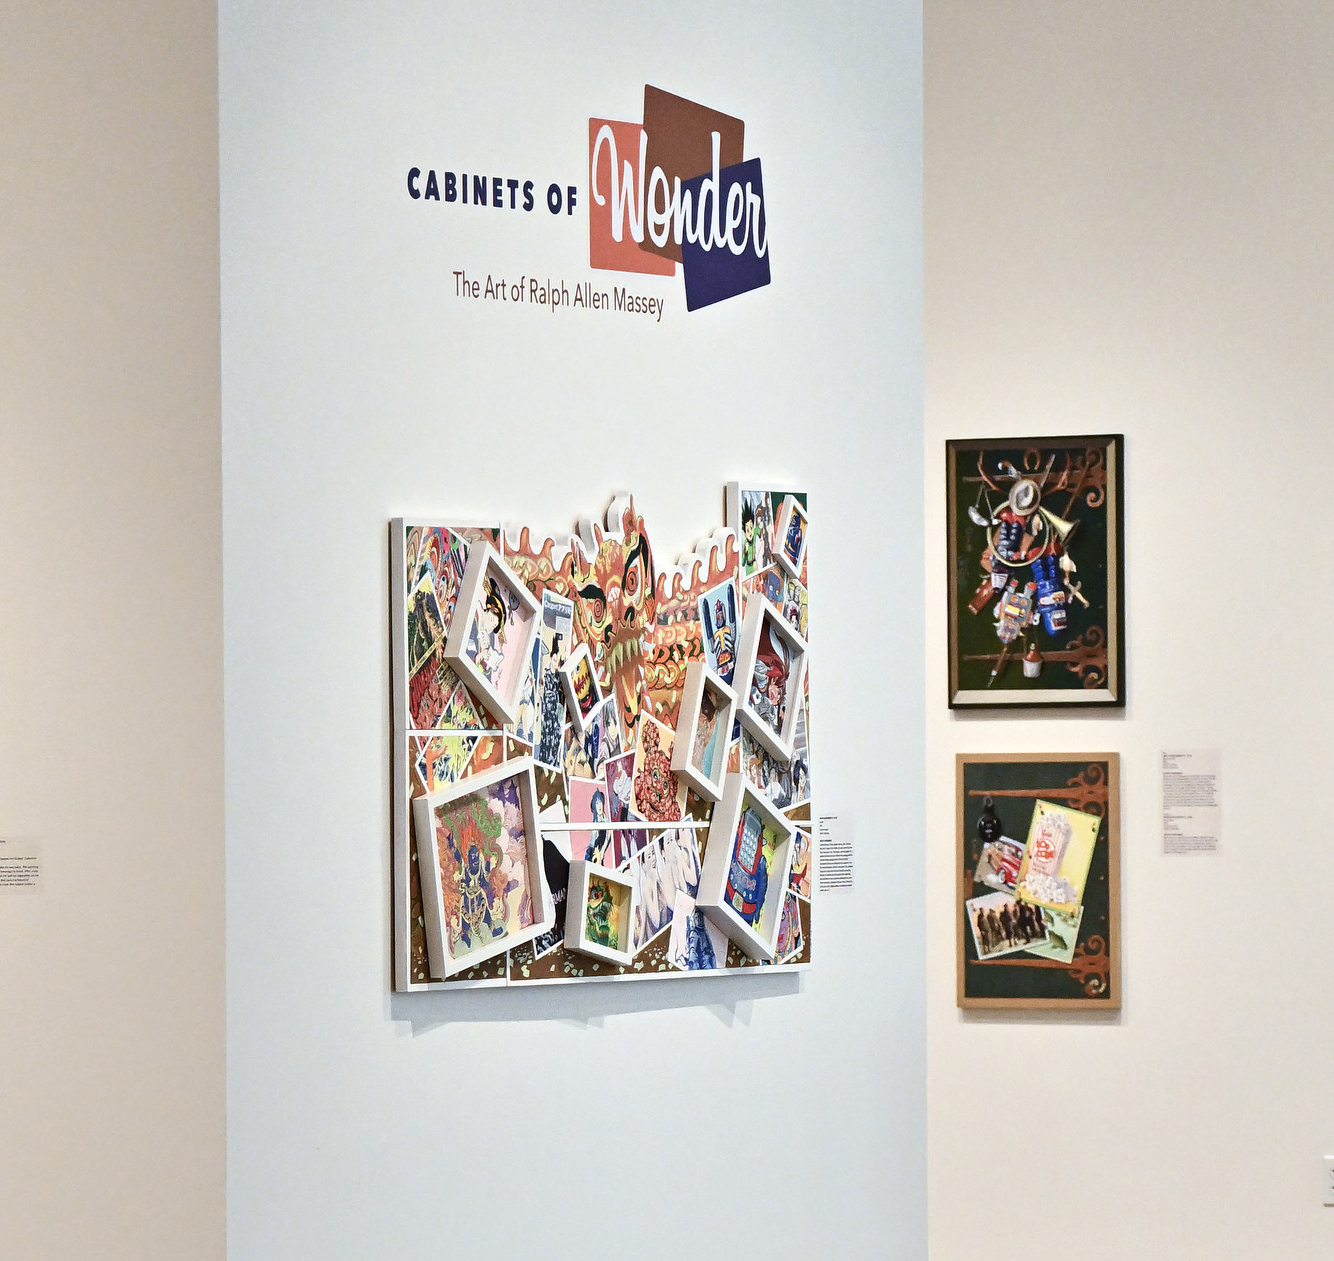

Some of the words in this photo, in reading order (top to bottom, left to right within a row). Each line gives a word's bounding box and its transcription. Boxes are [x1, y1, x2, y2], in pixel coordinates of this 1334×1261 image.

[407, 167, 535, 212] CABINETS
[547, 183, 578, 216] OF
[591, 124, 769, 259] Wonder
[453, 270, 480, 299] The
[484, 278, 507, 302] Art
[511, 279, 526, 303] of
[529, 278, 569, 313] Ralph
[574, 282, 609, 311] Allen
[614, 287, 664, 323] Massey
